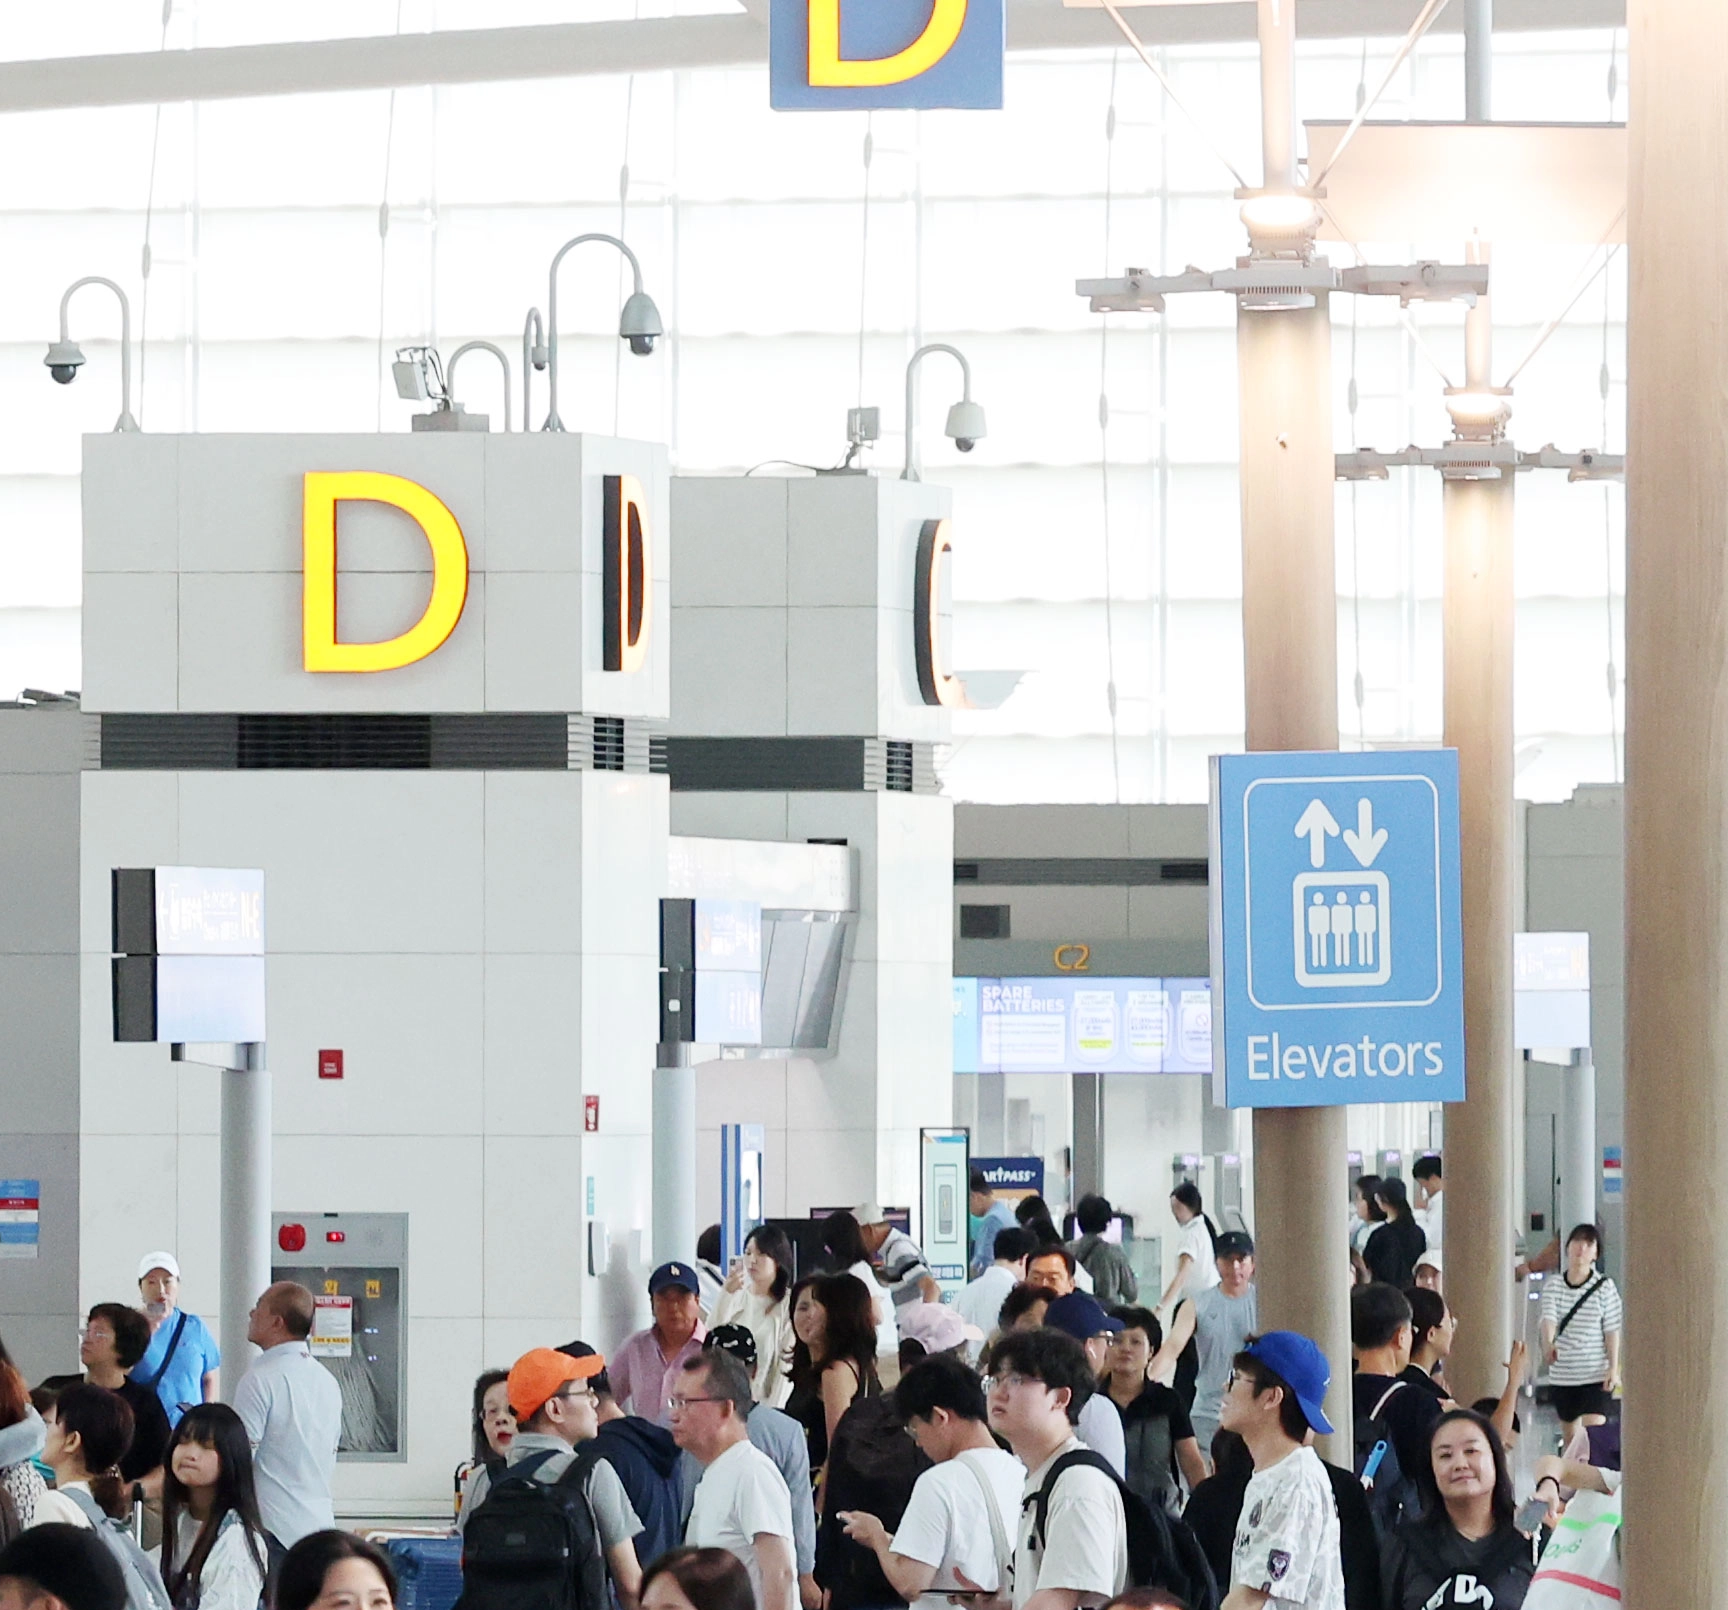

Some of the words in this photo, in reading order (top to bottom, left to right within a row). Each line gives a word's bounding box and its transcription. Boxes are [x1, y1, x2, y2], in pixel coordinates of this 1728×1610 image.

[303, 470, 470, 673] D
[1053, 944, 1090, 970] C2
[982, 985, 1033, 1000] SPARE
[982, 999, 1065, 1013] BATTERIES
[1246, 1031, 1444, 1081] Elevators
